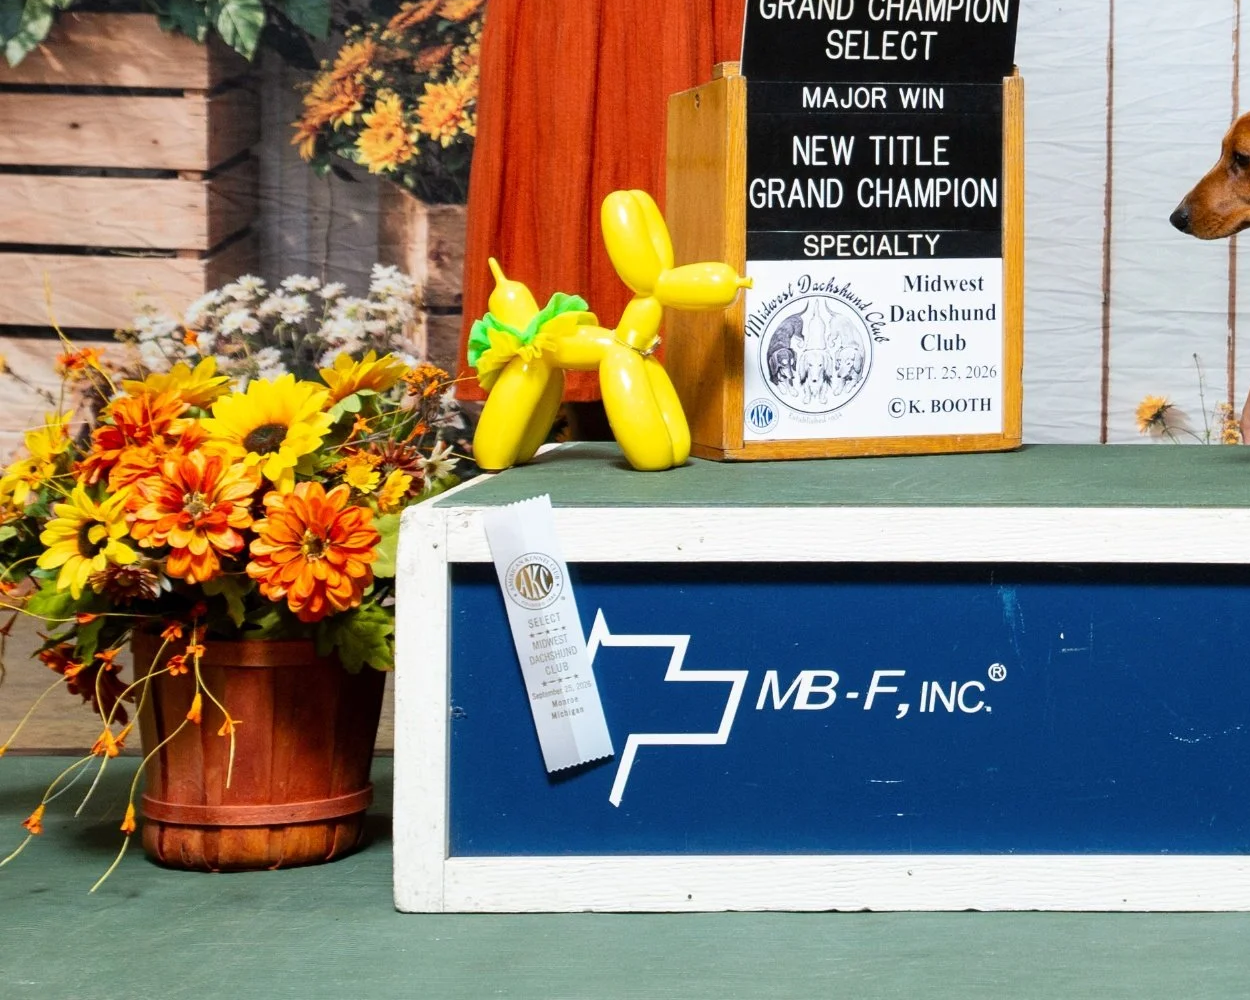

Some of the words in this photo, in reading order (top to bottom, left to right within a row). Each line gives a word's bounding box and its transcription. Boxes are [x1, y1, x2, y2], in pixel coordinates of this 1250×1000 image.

[825, 30, 938, 60] SELECT
[802, 86, 887, 109] MAJOR
[899, 87, 944, 109] WIN
[792, 135, 854, 166] NEW
[869, 135, 950, 166] TITLE
[749, 178, 843, 209] GRAND
[857, 177, 997, 208] CHAMPION
[803, 234, 940, 257] SPECIALTY
[903, 275, 984, 292] Midwest
[744, 282, 794, 338] Midwest
[797, 274, 873, 311] Dachshund
[865, 311, 890, 344] Club
[890, 304, 996, 322] Dachshund
[920, 333, 967, 351] Club
[896, 366, 937, 380] SEPT.
[965, 365, 997, 379] 2026
[930, 398, 992, 413] BOOTH
[750, 404, 773, 428] AKC
[518, 564, 553, 600] AKC
[528, 612, 560, 629] SELECT
[532, 634, 567, 650] MIDWEST
[529, 645, 578, 665] DACHSHUND
[544, 662, 569, 676] CLUB
[531, 688, 562, 700] September
[576, 680, 592, 690] 2026
[551, 696, 579, 708] Monroe
[551, 707, 584, 720] Michigan
